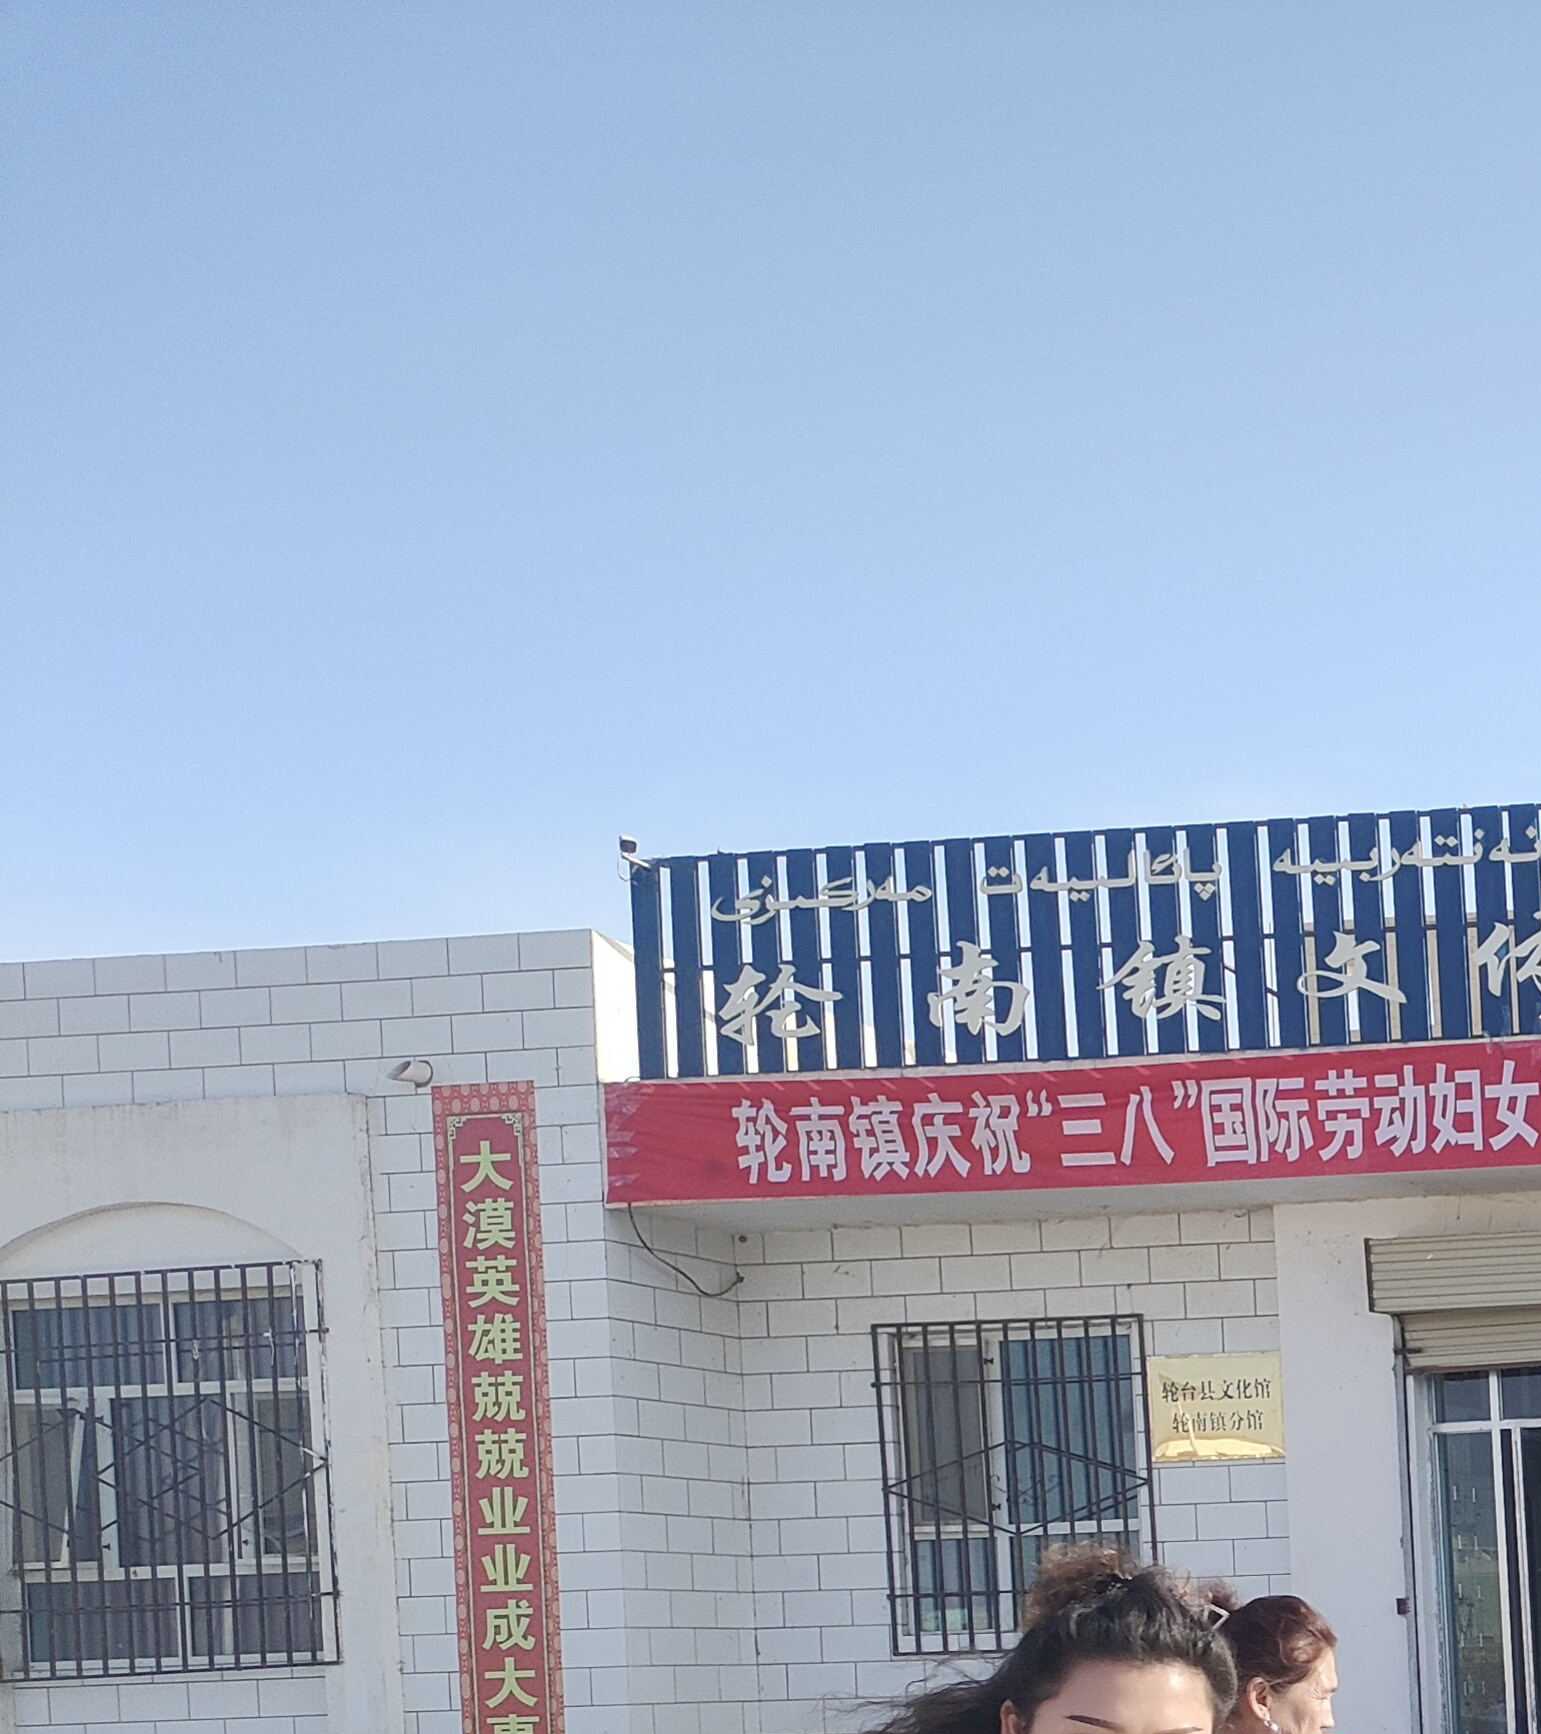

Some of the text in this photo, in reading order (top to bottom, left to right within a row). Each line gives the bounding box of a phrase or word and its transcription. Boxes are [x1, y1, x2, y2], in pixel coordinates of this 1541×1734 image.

[1161, 1377, 1272, 1402] 轮台县文化馆
[1172, 1409, 1264, 1434] 轮南镇分馆
